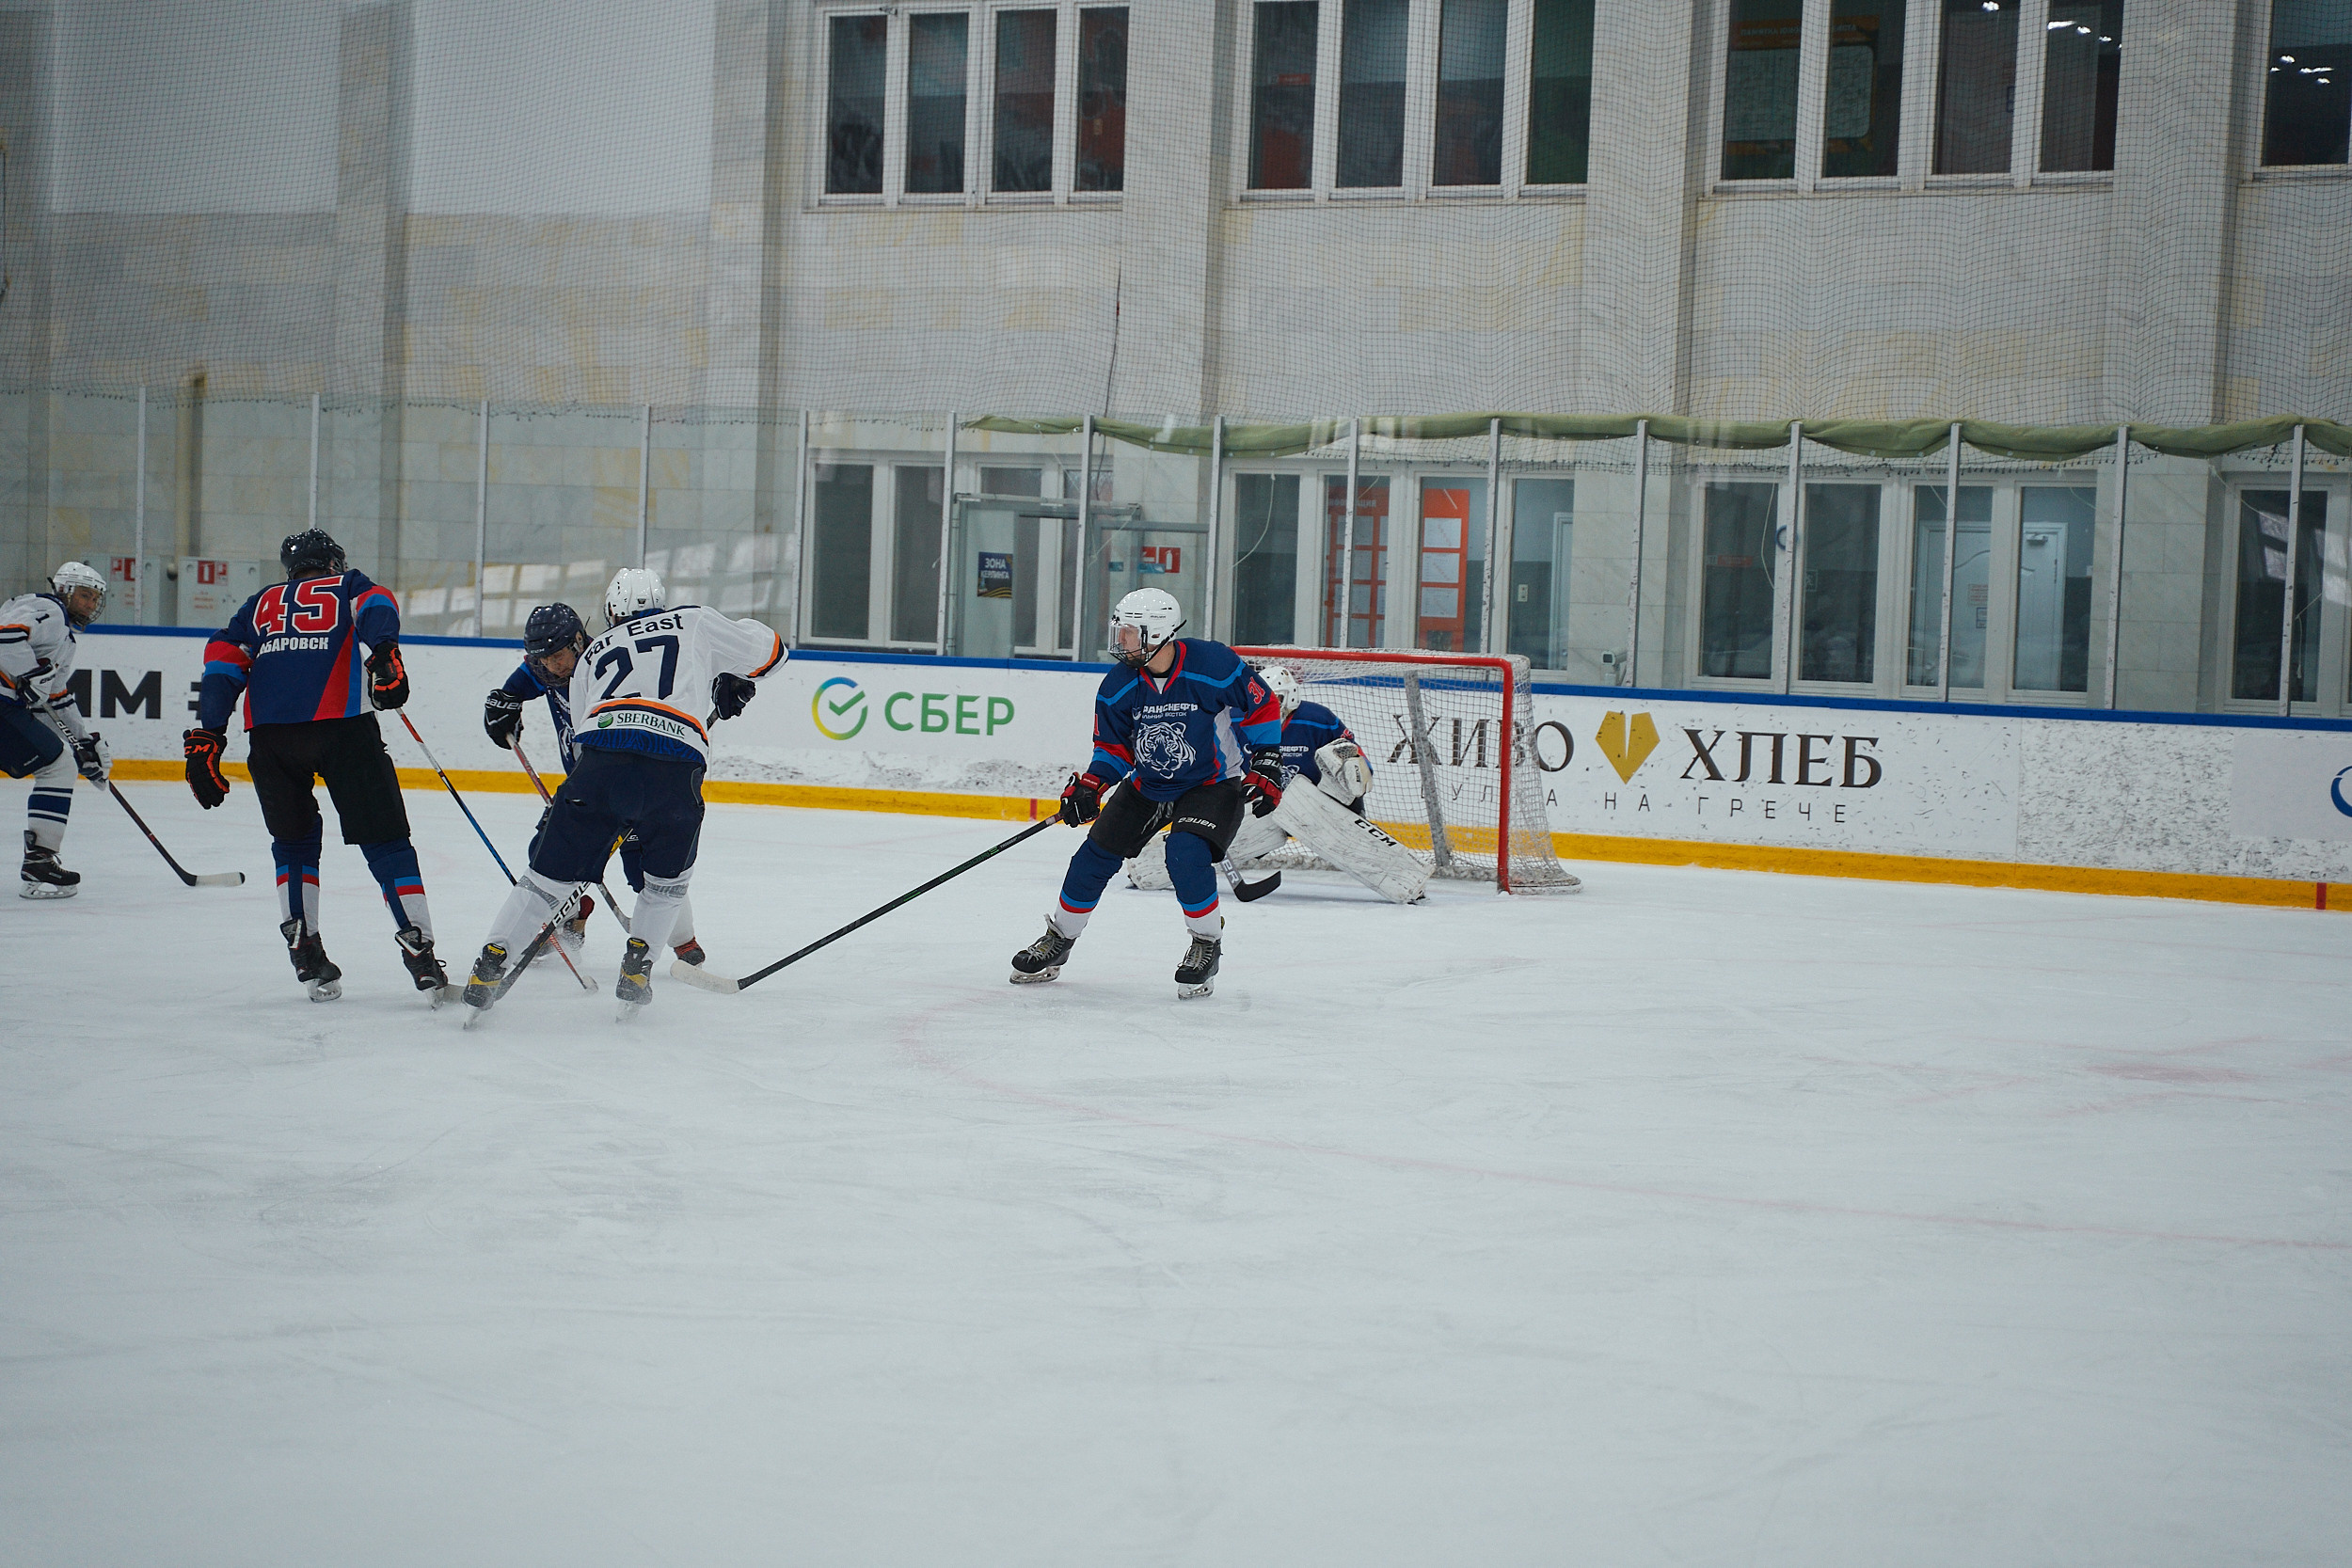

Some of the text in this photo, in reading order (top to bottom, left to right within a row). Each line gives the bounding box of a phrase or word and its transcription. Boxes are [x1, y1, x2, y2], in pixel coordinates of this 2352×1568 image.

[985, 558, 1007, 569] ЗОНА
[253, 575, 344, 637] 45
[256, 637, 329, 658] АБАРОВСК
[584, 613, 684, 666] Far East
[595, 634, 680, 701] 27
[616, 712, 686, 736] SBERBANK
[884, 691, 1015, 736] СБЕР
[1679, 728, 1883, 788] ХЛЕБ
[1604, 792, 1650, 812] НА
[1698, 796, 1846, 823] ГРЕЧЕ
[1355, 818, 1397, 847] CCM
